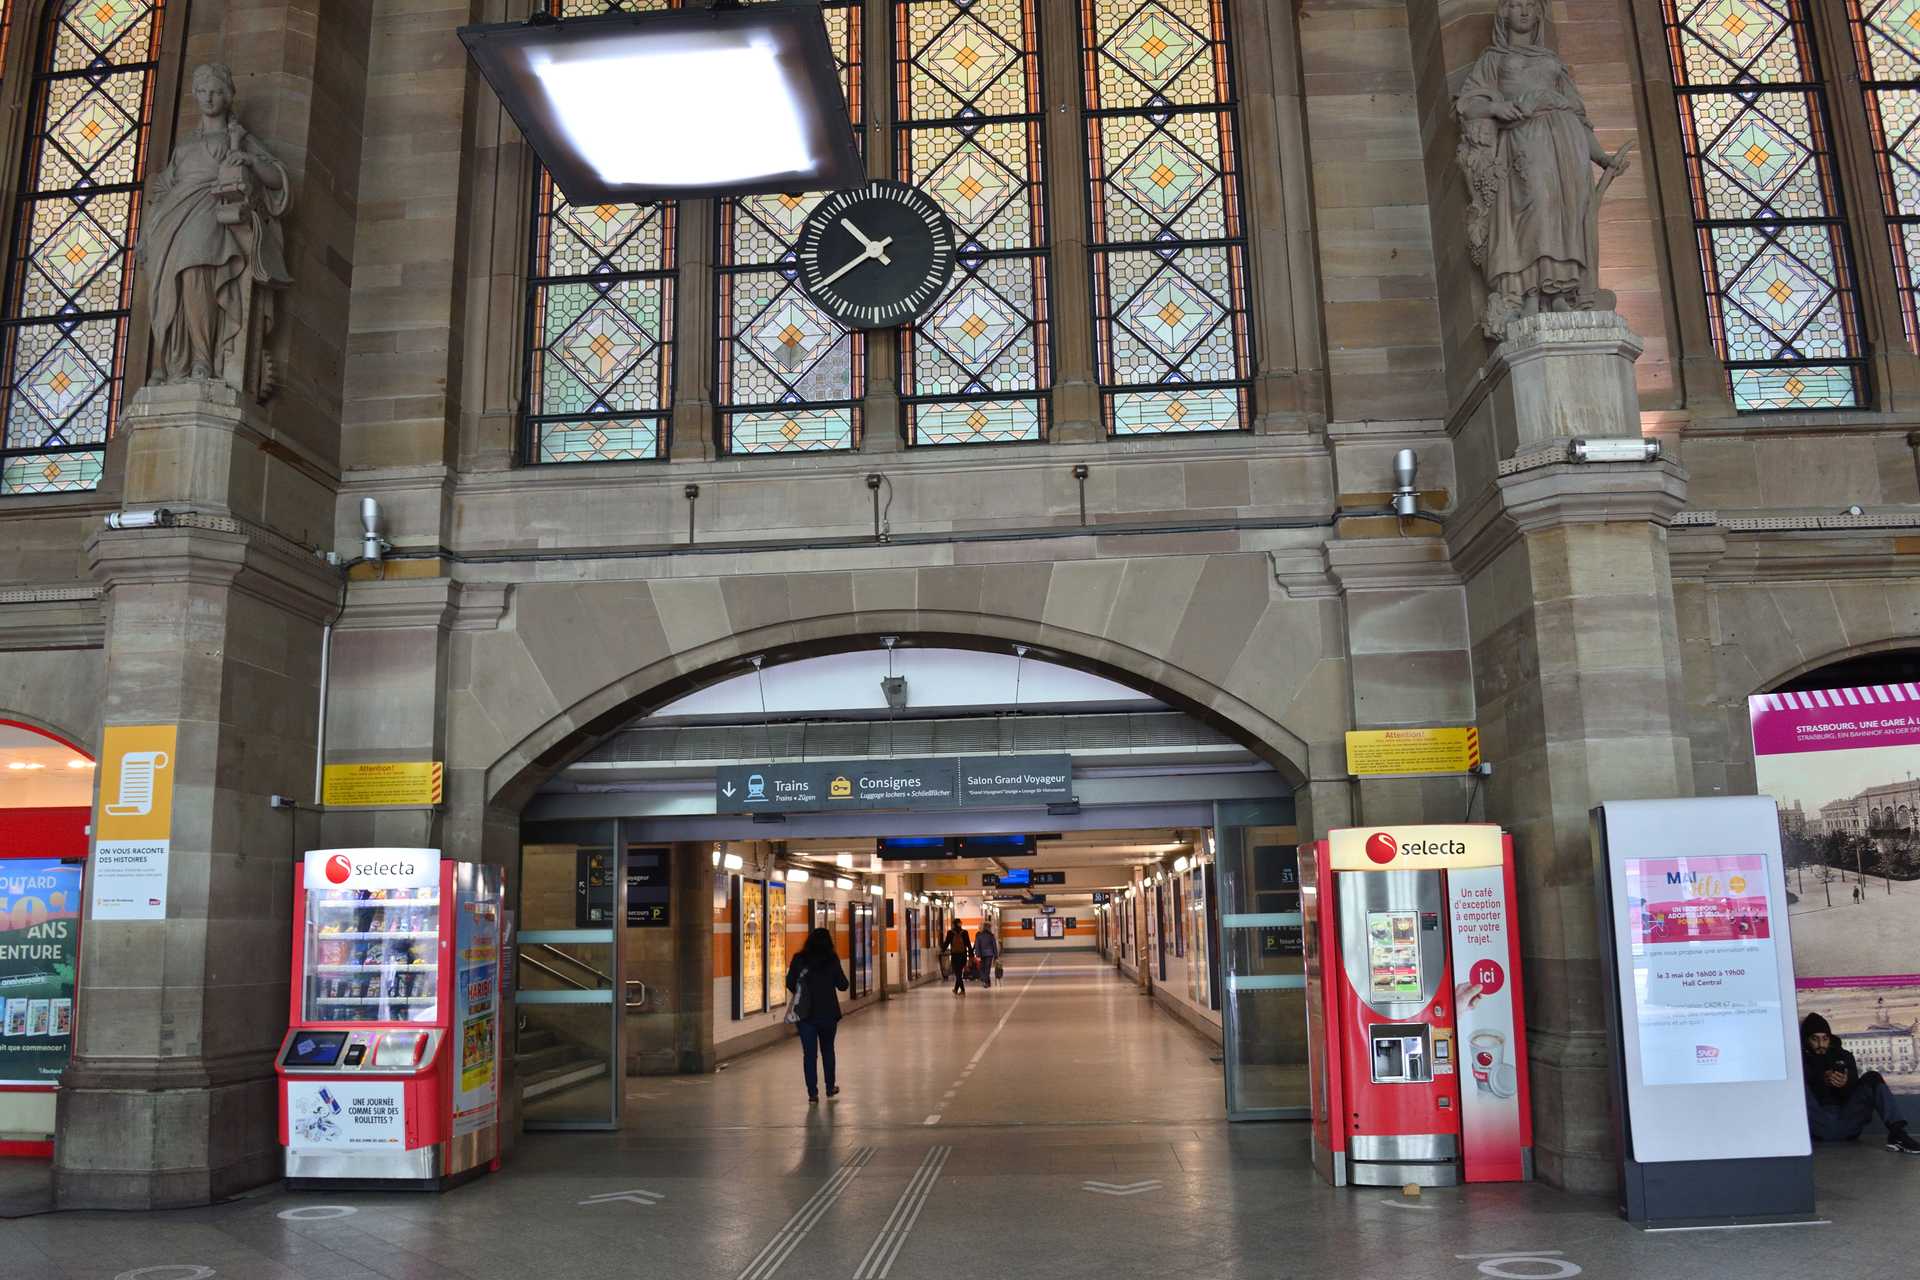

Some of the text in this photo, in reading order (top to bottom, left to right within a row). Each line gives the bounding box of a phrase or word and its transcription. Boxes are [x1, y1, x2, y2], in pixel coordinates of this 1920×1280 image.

[1796, 722, 1857, 733] STRASBOURG,
[1860, 720, 1879, 728] UNE
[1881, 718, 1905, 727] GARE
[1908, 715, 1915, 725] À
[1838, 731, 1849, 739] EIN
[775, 775, 1065, 792] Trains Consignes Salon Grand Voyageur
[1401, 840, 1466, 855] selecta
[355, 861, 415, 876] selecta
[1667, 871, 1697, 884] MAI
[1461, 887, 1493, 898] Un café
[1455, 901, 1501, 911] d'exception
[1456, 912, 1501, 922] à emporter
[27, 922, 68, 939] ANS
[1458, 923, 1500, 934] pour votre
[1480, 967, 1495, 983] ici
[1697, 978, 1722, 986] Central
[352, 1096, 394, 1106] UNE JOURNÉE
[348, 1107, 399, 1115] COMME SUR DES
[355, 1116, 387, 1124] ROULETTES
